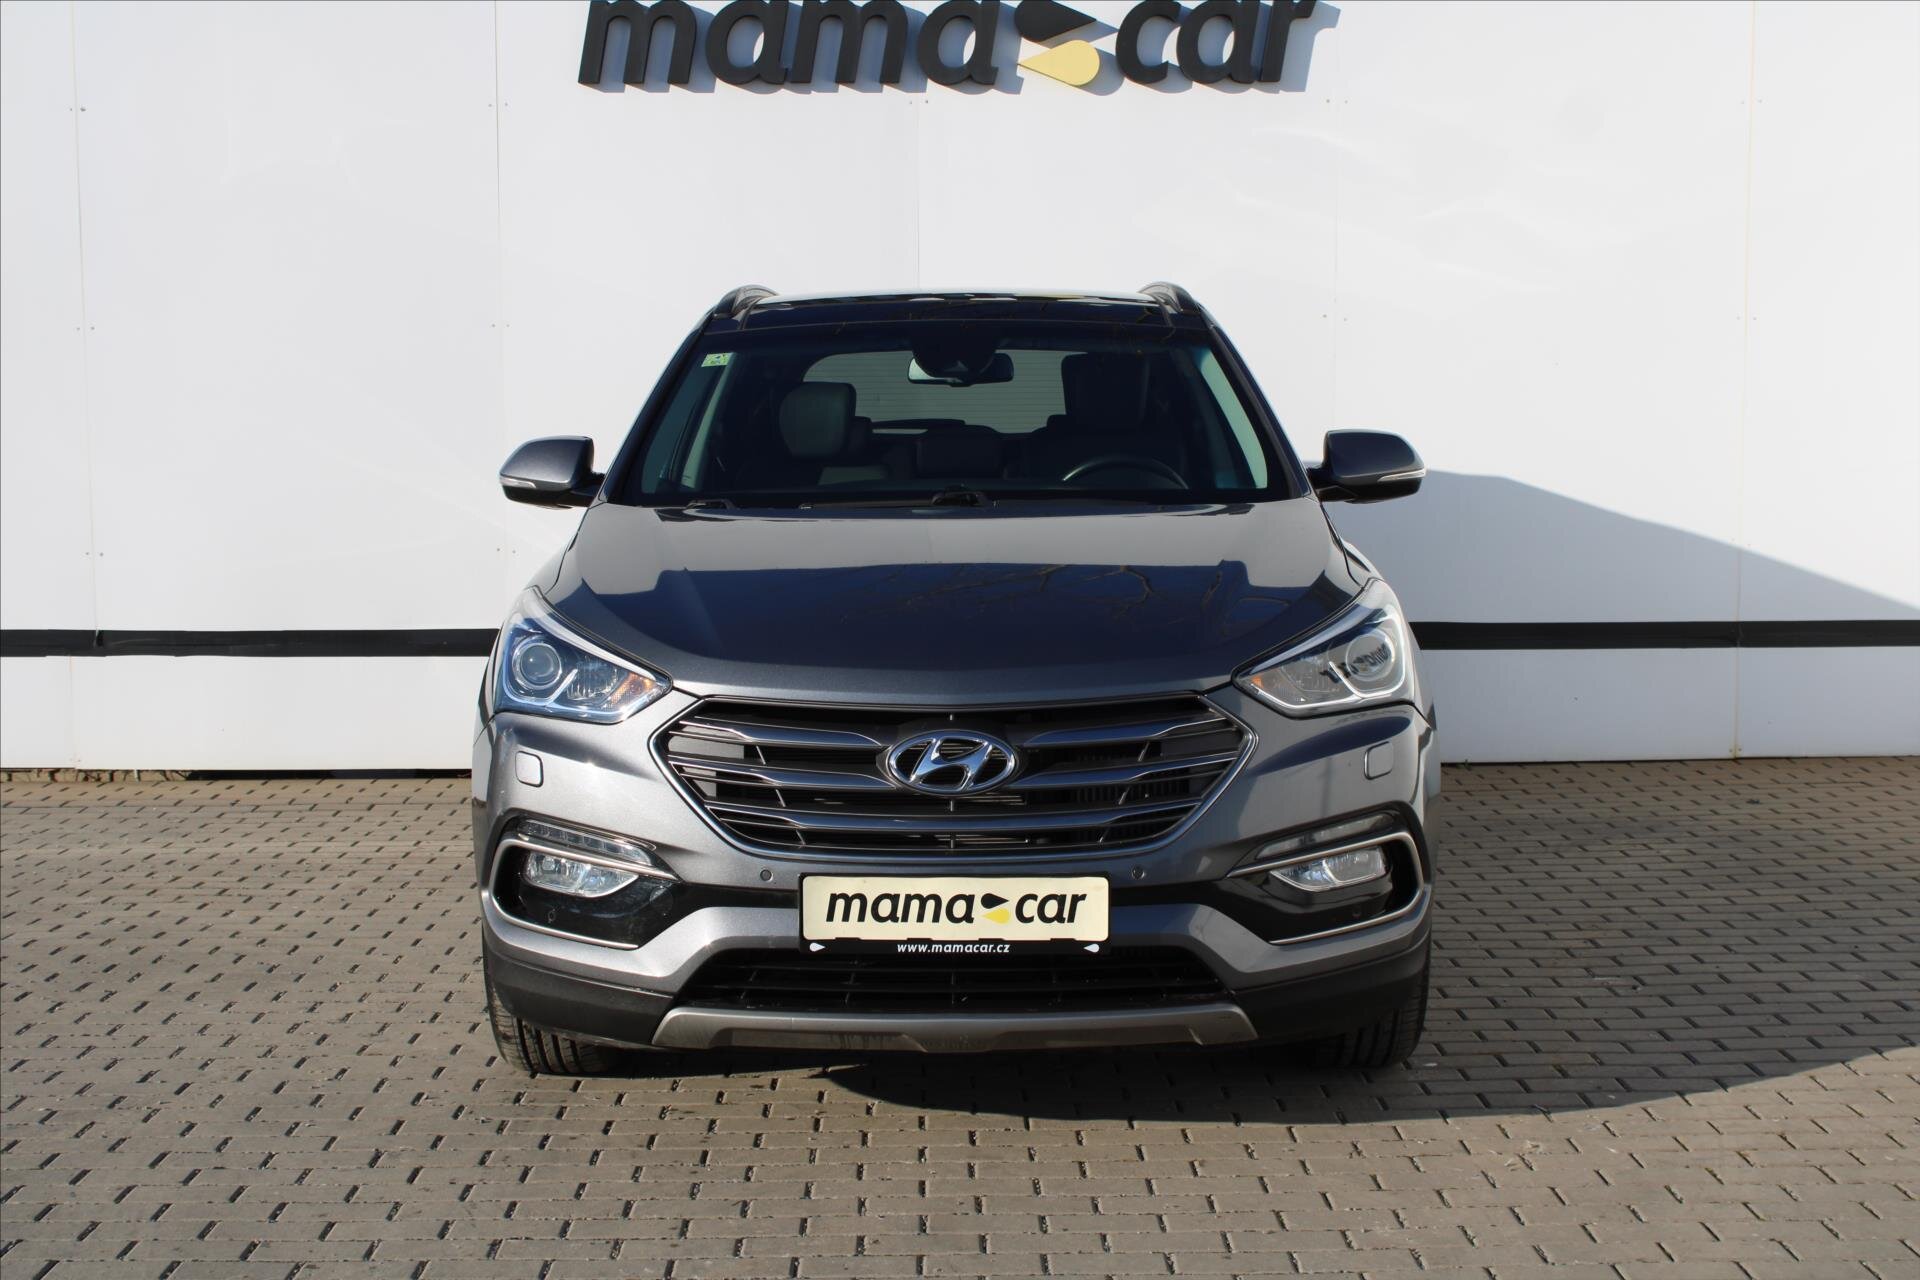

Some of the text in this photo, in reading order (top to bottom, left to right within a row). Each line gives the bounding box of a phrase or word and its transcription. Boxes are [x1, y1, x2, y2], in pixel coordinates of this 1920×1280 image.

[578, 0, 1317, 85] mama car
[826, 892, 1087, 924] mama car
[897, 943, 1010, 954] www.mamacar.cz
